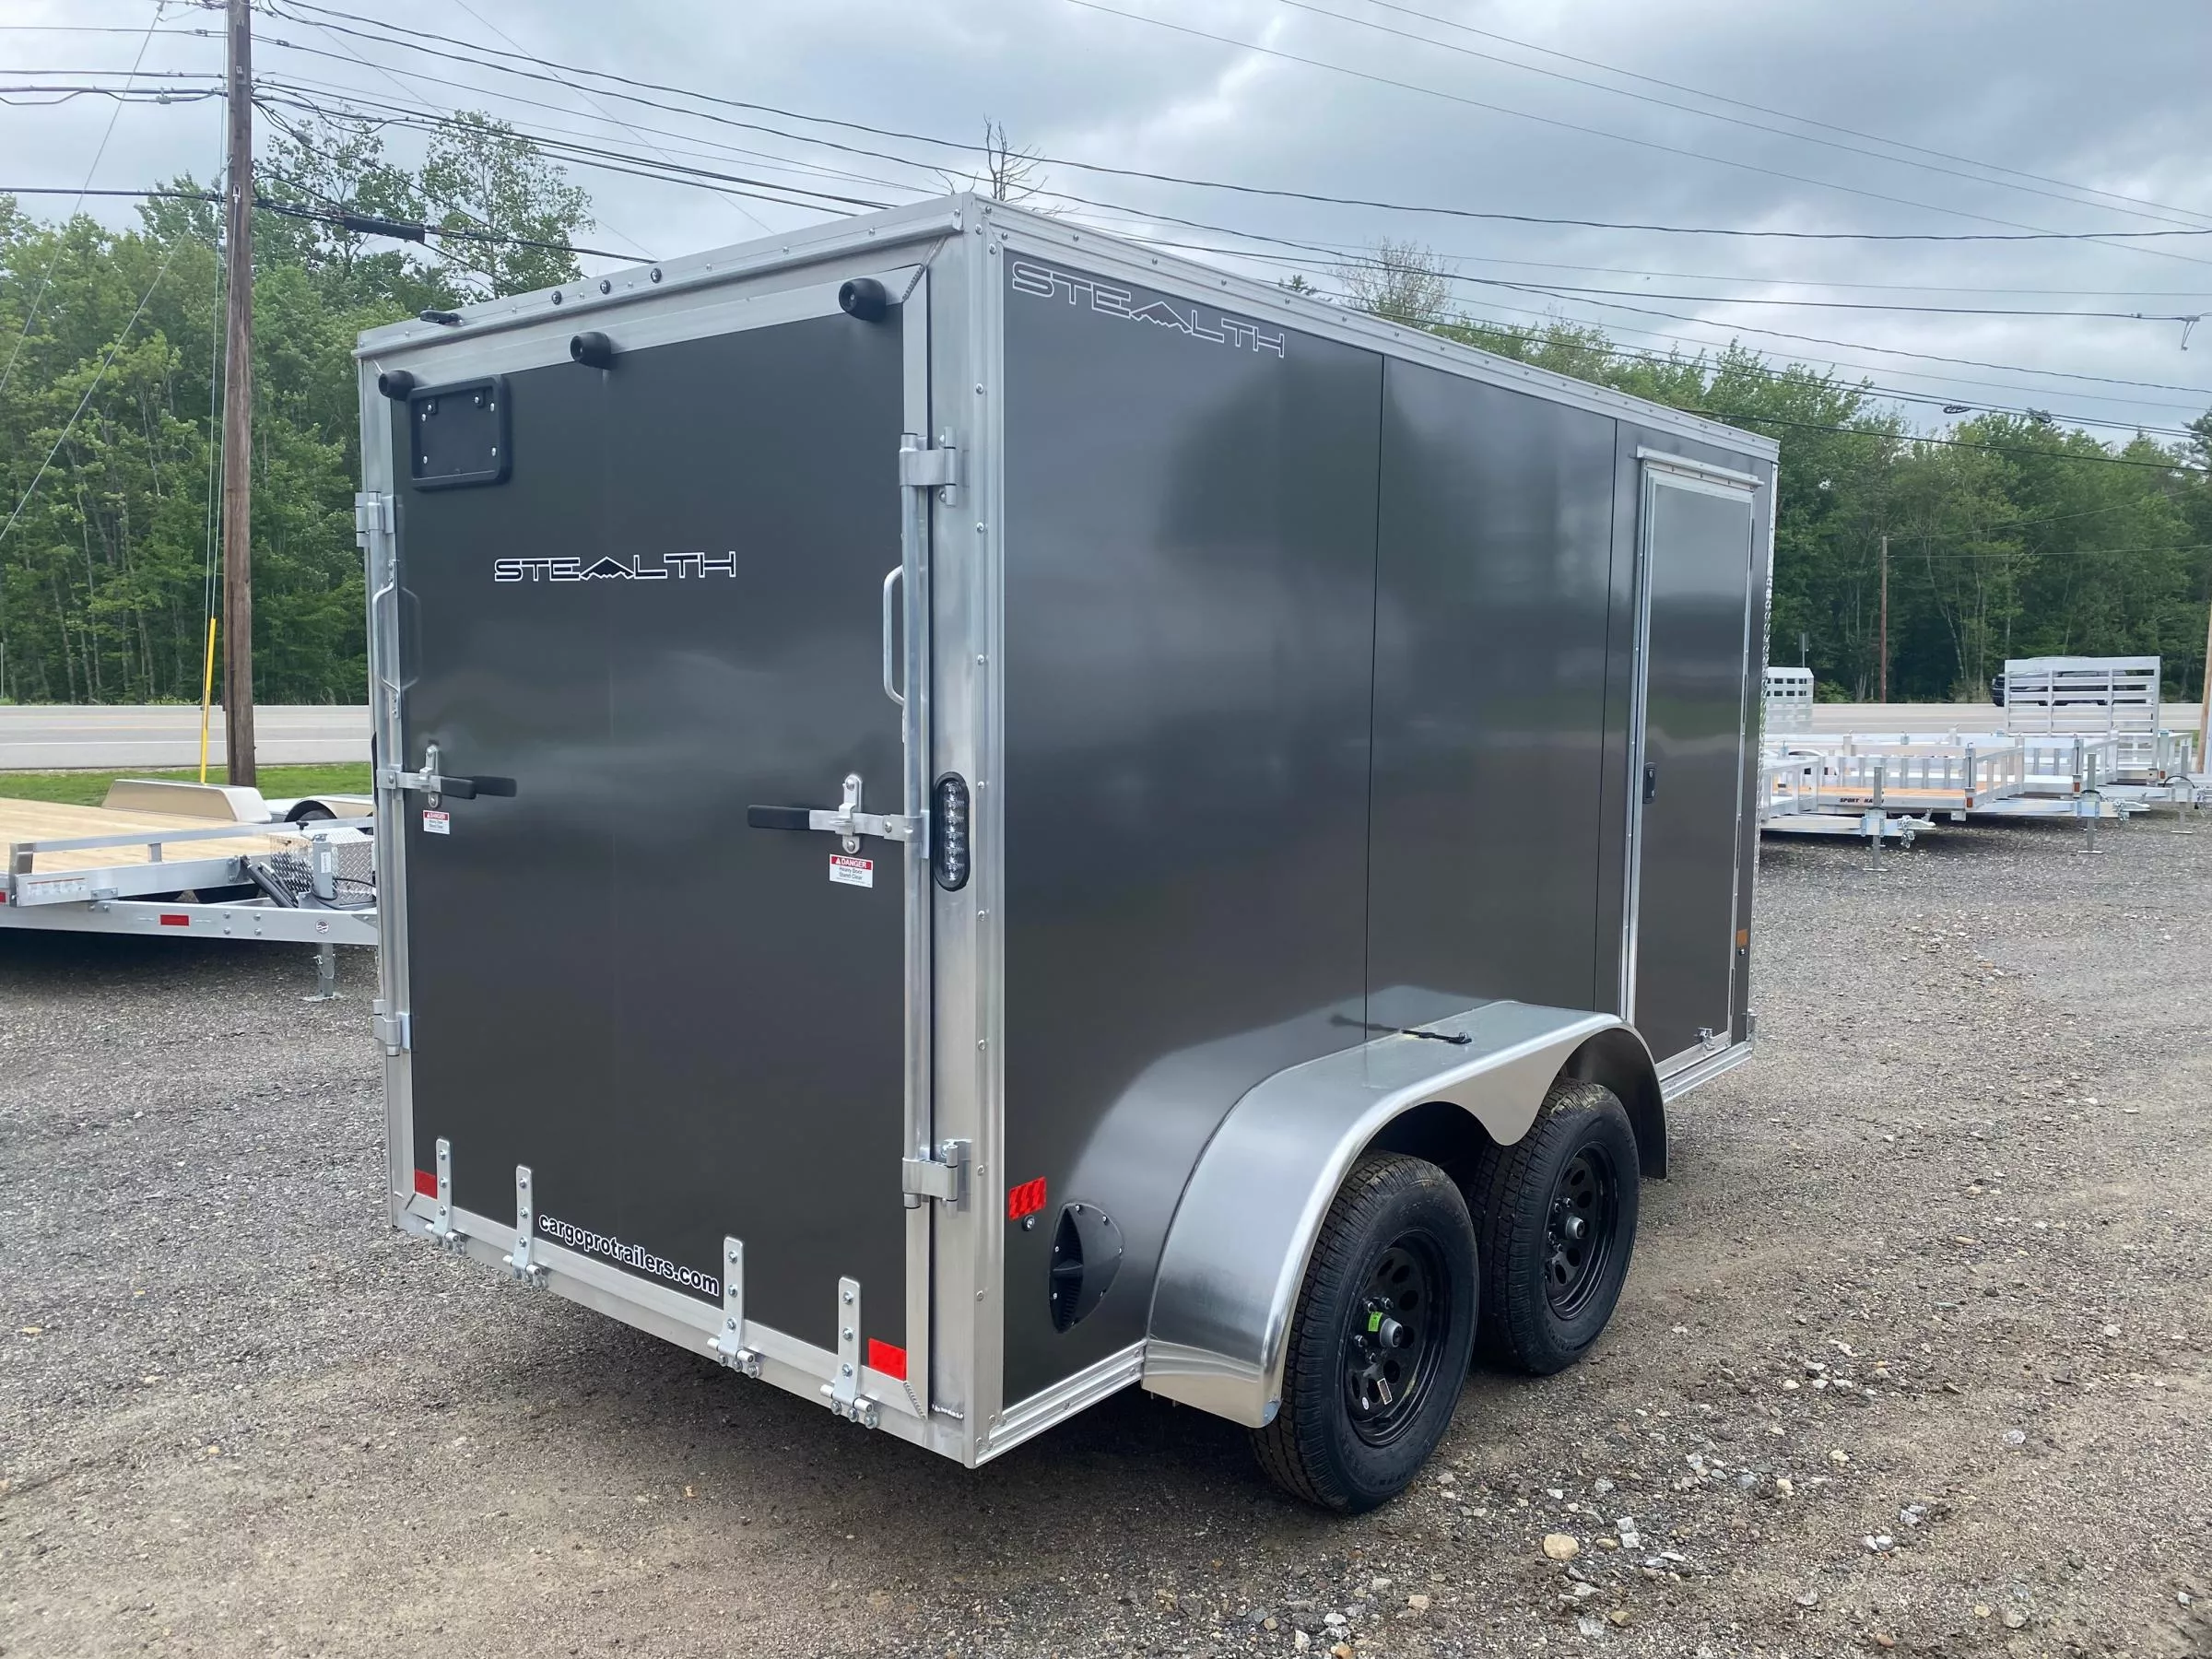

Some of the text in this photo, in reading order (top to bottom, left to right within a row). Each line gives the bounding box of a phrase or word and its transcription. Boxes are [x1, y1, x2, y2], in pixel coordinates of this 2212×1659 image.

[1012, 261, 1285, 359] STEALTH
[494, 550, 736, 582] STEALTH
[841, 858, 867, 869] DANGER
[538, 1214, 720, 1297] cargoprotrailers.com
